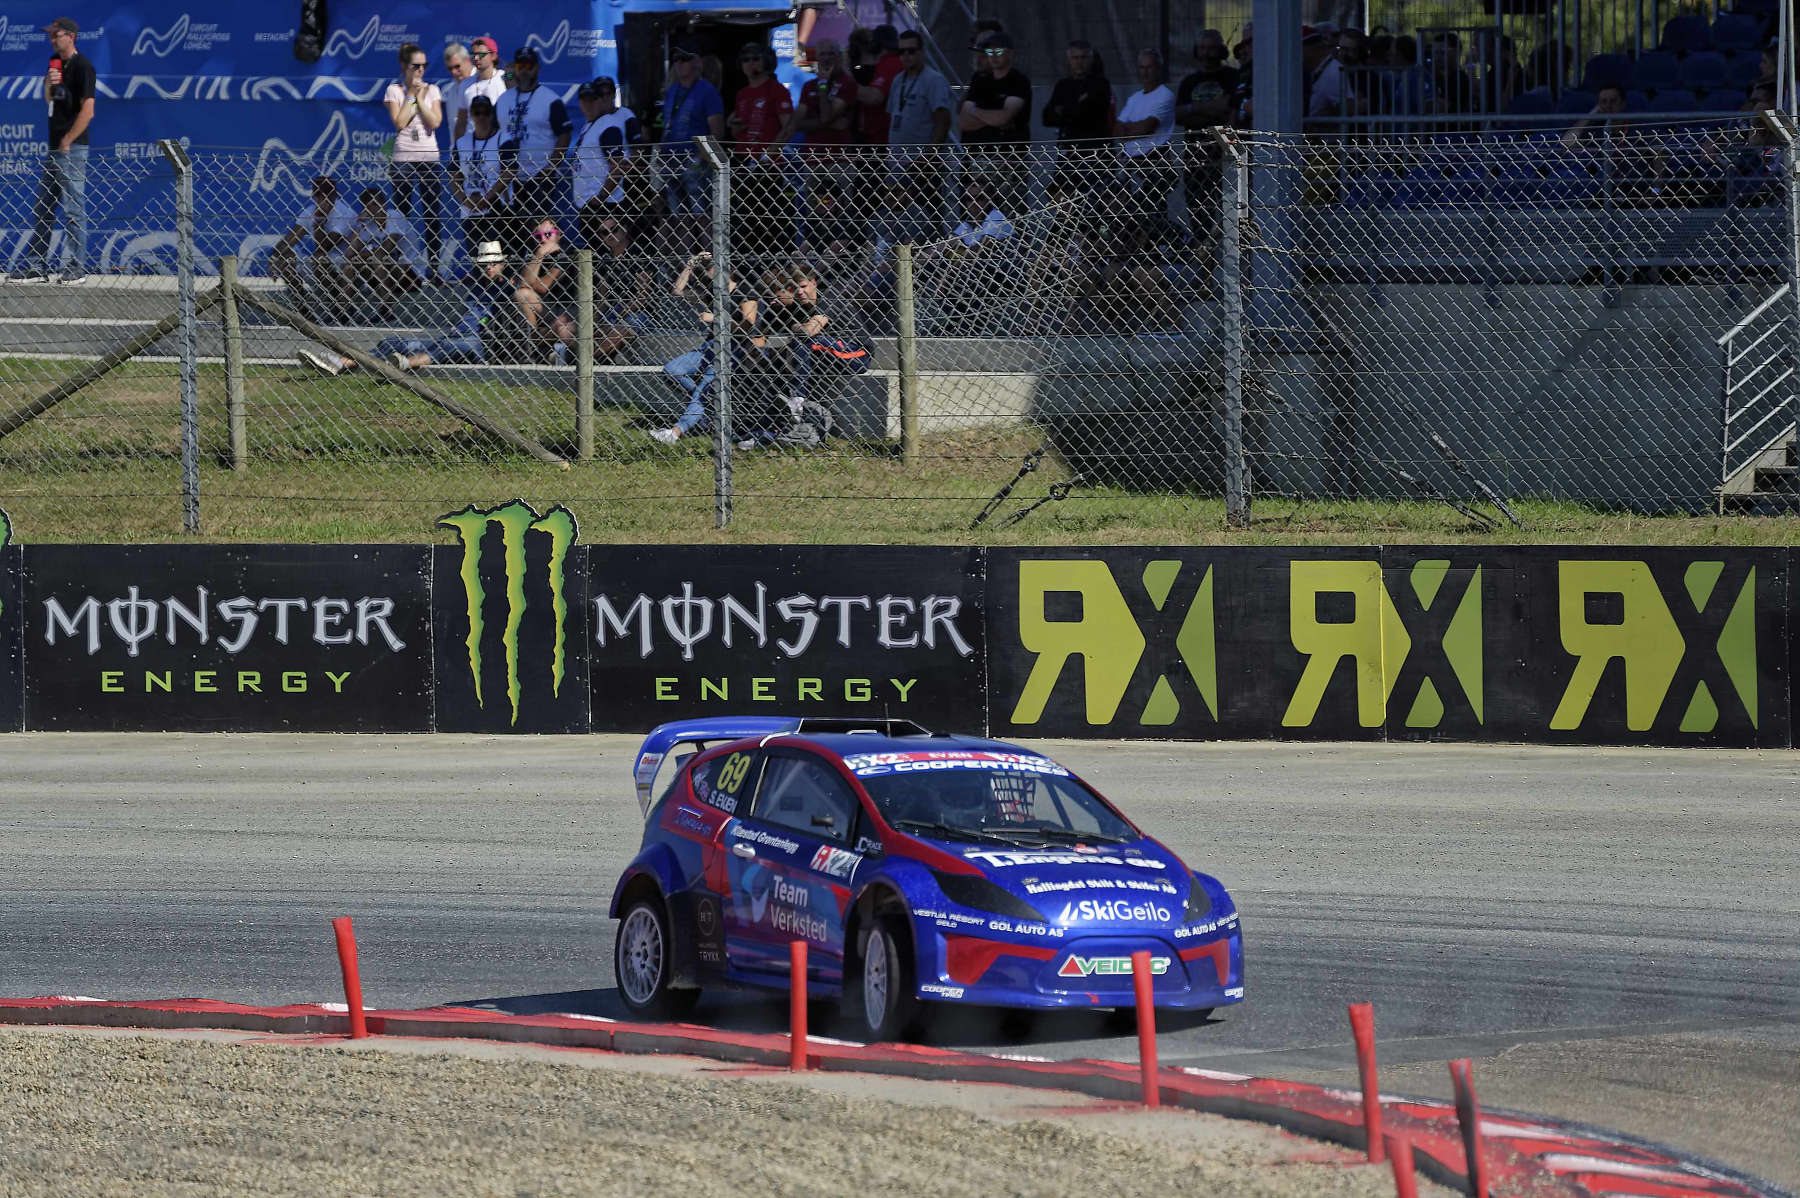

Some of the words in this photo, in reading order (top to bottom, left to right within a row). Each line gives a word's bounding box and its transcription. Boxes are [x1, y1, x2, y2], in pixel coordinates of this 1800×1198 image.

[42, 585, 407, 657] MONSTER
[593, 580, 976, 662] MONSTER
[1011, 559, 1219, 726] RX
[1281, 559, 1484, 729] RX
[1550, 560, 1759, 732] RX
[101, 671, 351, 693] ENERGY
[655, 677, 918, 702] ENERGY
[717, 752, 751, 794] 69
[773, 875, 809, 907] Team
[1026, 880, 1087, 895] Hallingdal
[770, 903, 827, 942] Verksted
[950, 913, 985, 925] RESORT
[1079, 900, 1171, 922] SkiGeilo
[989, 920, 1012, 932] GOL
[1014, 924, 1046, 936] AUTO
[1048, 928, 1064, 938] AS
[1174, 928, 1191, 939] GOL
[1192, 924, 1208, 936] AUTO
[1078, 959, 1166, 974] VEIDC
